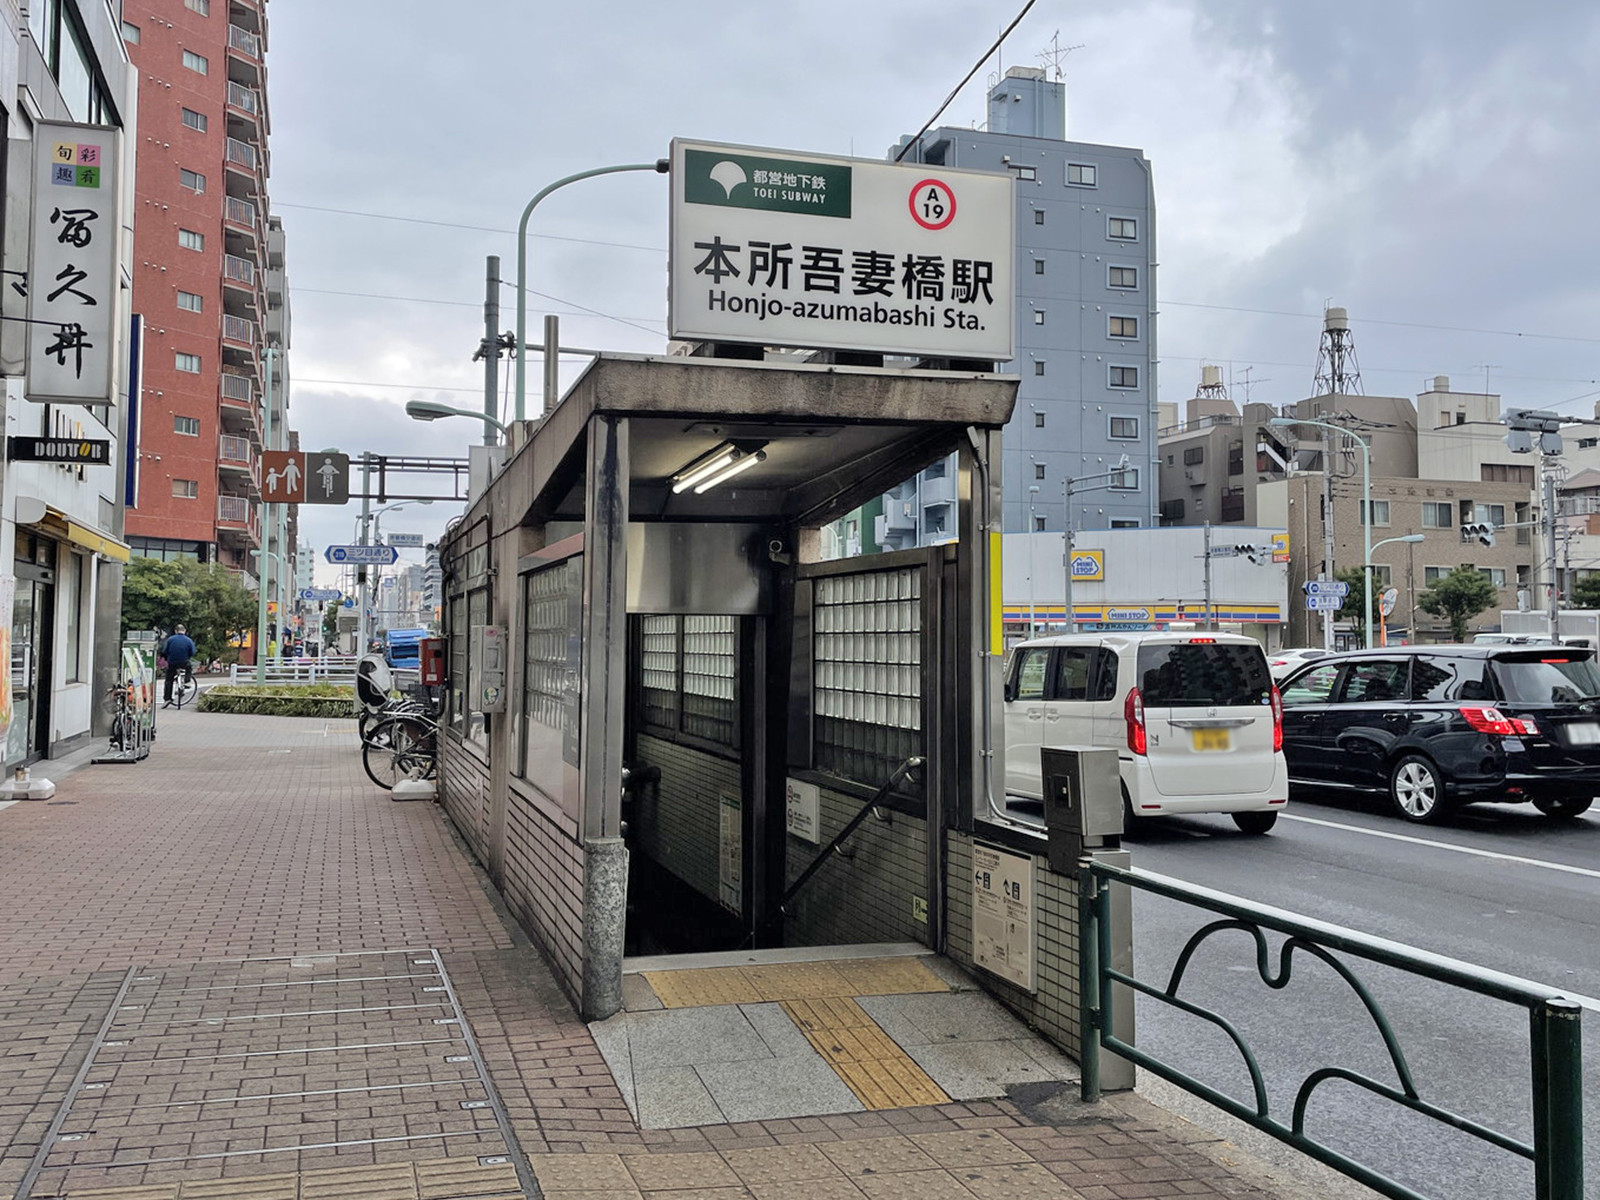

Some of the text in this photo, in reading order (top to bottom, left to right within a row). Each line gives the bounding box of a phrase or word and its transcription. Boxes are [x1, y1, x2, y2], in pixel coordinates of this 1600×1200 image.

[753, 169, 827, 191] 都営地下鉄
[753, 187, 826, 204] TOEI SUBWAY
[927, 188, 939, 201] A
[923, 203, 944, 219] 19
[694, 235, 994, 306] 本所吾妻橋駅
[708, 289, 986, 331] Honjo-azumabashi Sta.
[35, 441, 102, 459] DOUTOR
